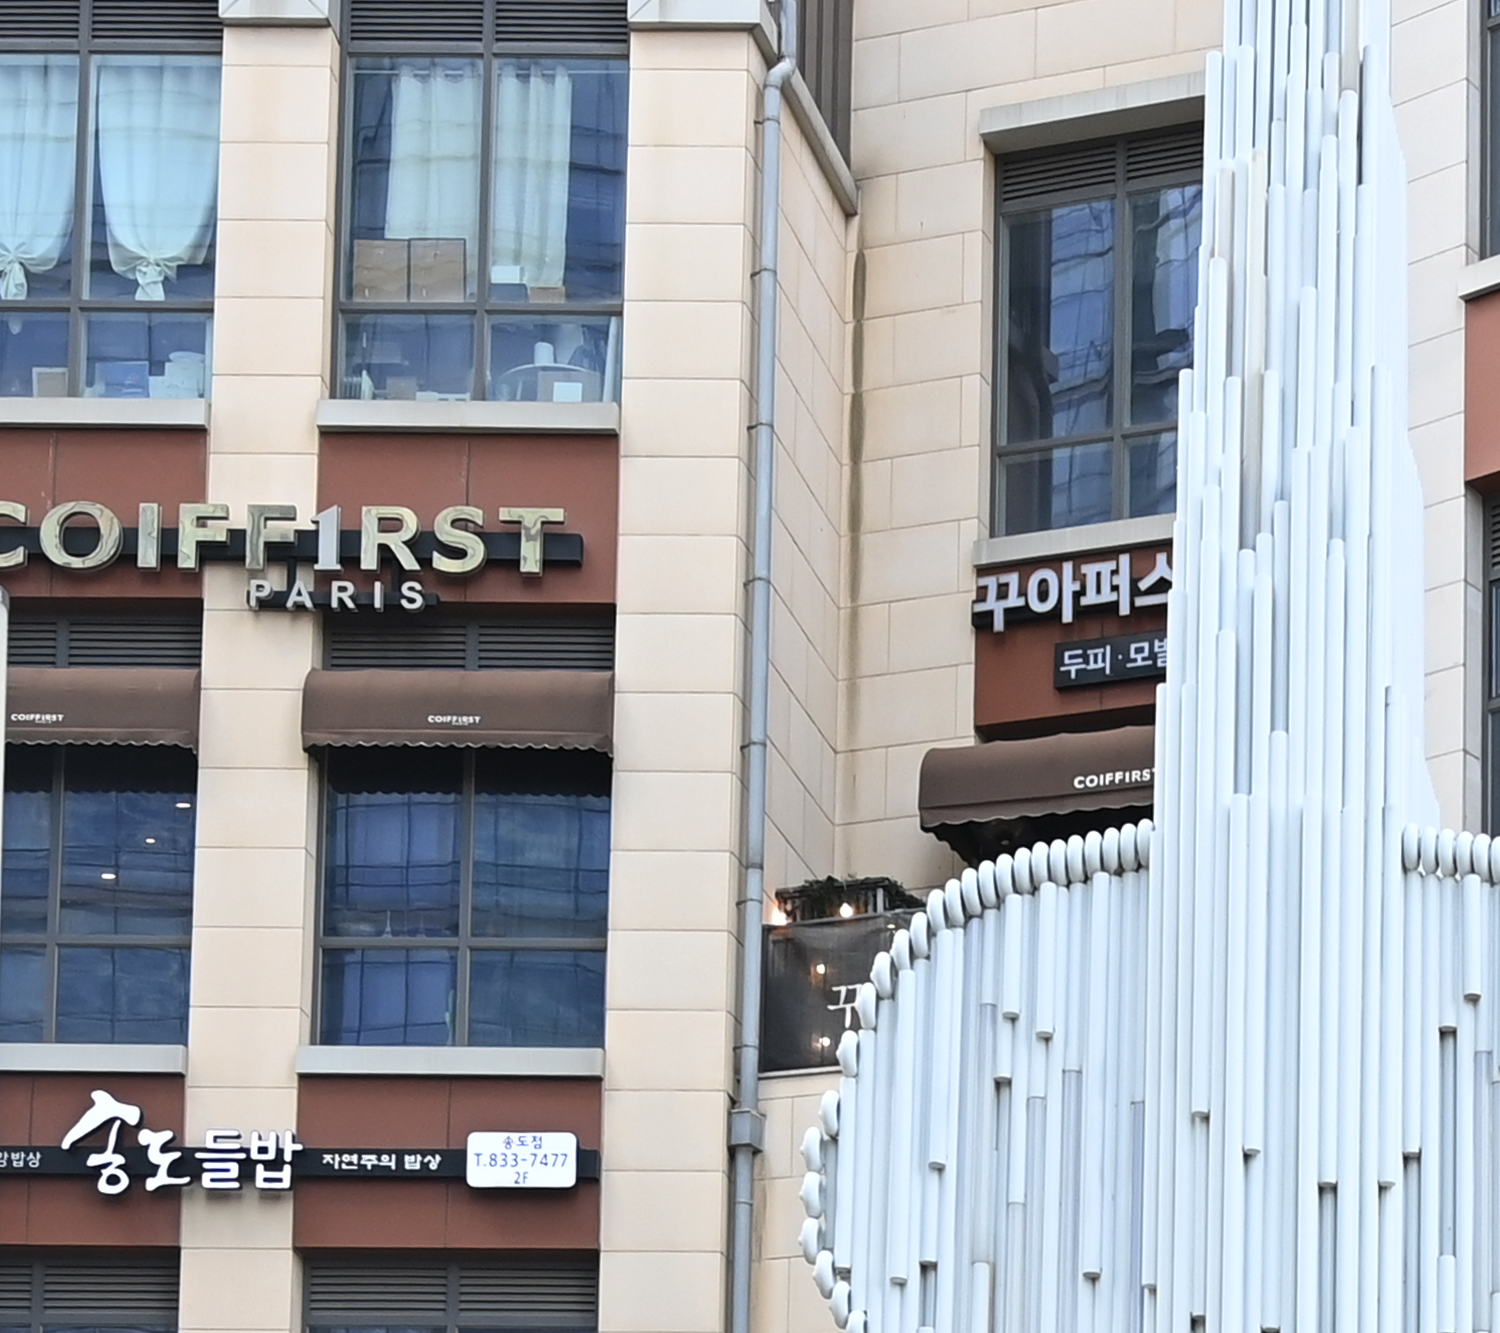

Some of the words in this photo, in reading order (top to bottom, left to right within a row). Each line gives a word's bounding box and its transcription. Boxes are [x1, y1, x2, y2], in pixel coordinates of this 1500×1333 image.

[249, 580, 426, 612] PARIS
[61, 1090, 304, 1195] 송도들밥
[502, 1135, 543, 1150] 송도점
[322, 1153, 397, 1170] 자연주의
[404, 1153, 442, 1170] 밥상
[473, 1153, 569, 1168] T.833-7477
[513, 1171, 529, 1185] 2F
